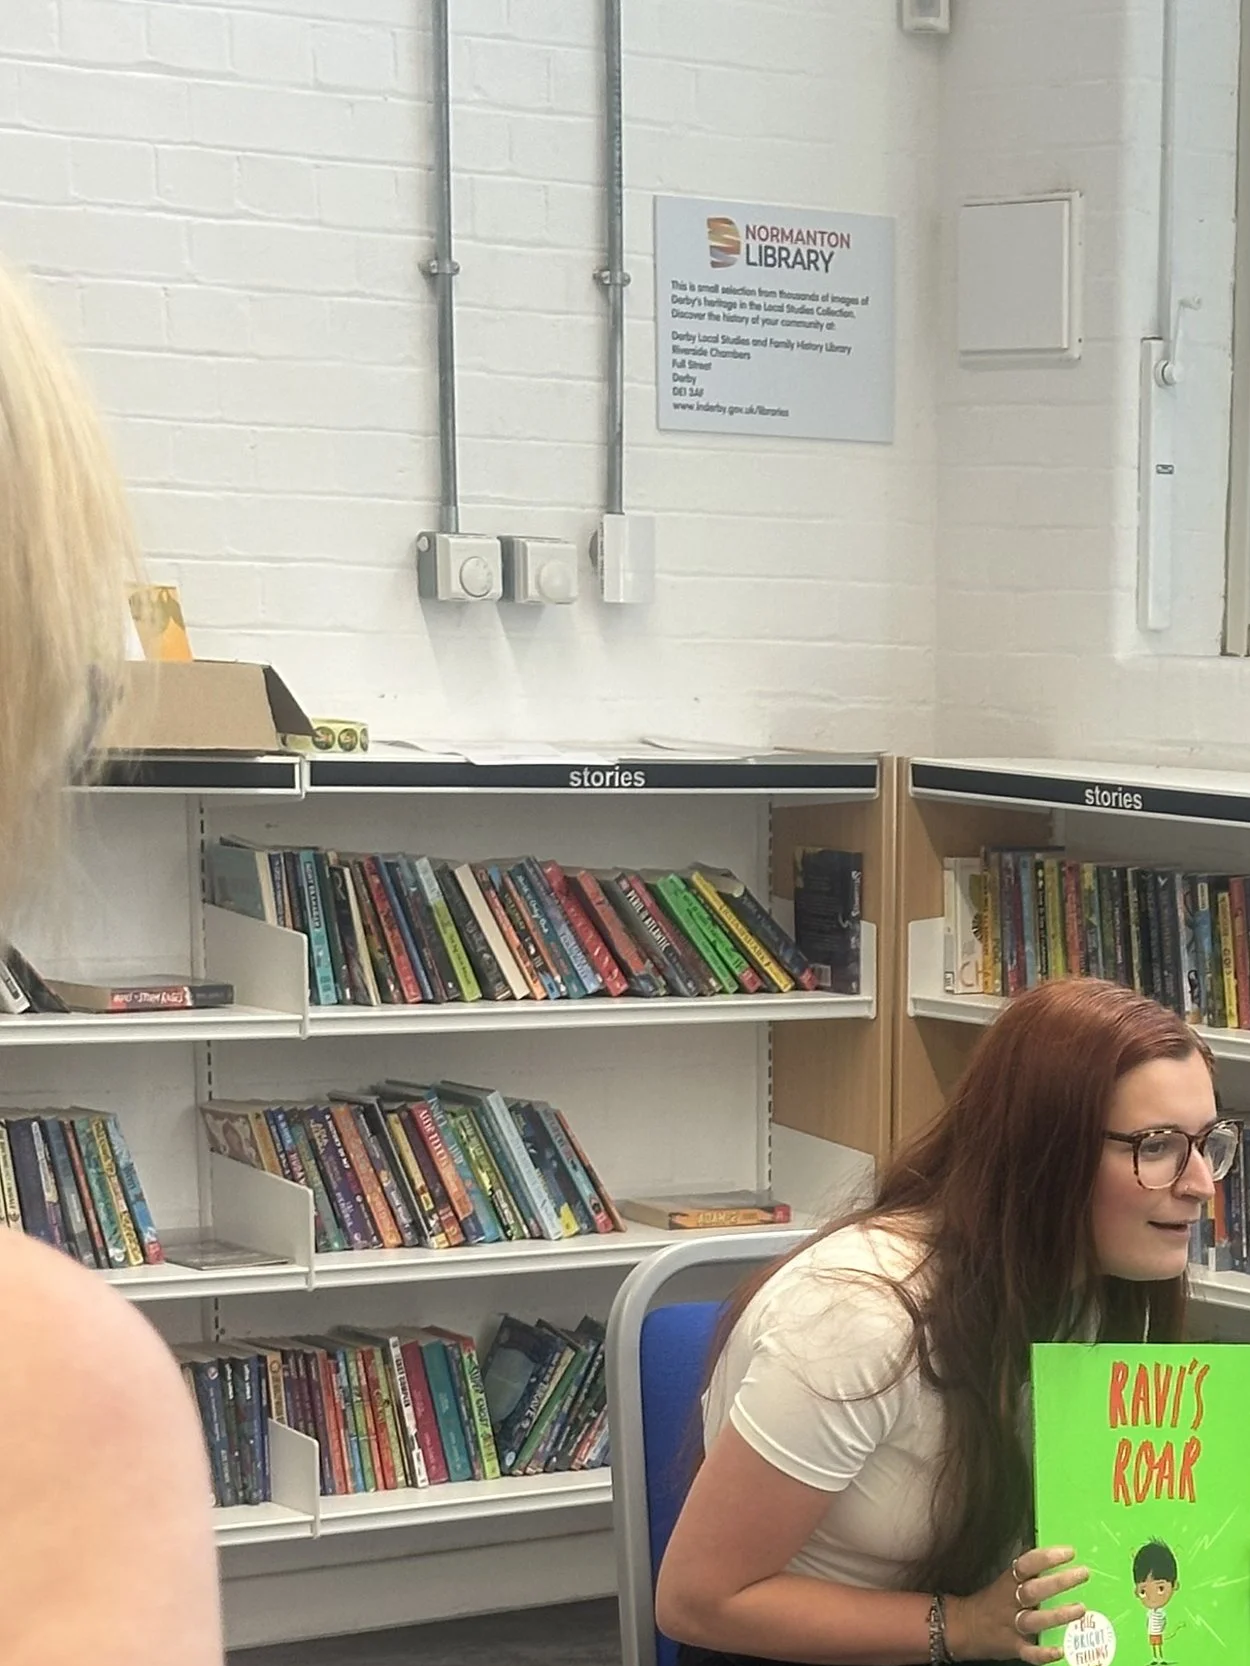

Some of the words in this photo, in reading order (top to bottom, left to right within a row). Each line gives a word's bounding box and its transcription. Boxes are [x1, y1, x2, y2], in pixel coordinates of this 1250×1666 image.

[745, 224, 851, 249] NORMANTON
[745, 244, 835, 273] LIBRARY
[671, 294, 702, 308] Derby's
[703, 297, 737, 311] heritage
[764, 302, 784, 313] Local
[786, 303, 815, 315] Studies
[689, 282, 696, 292] is
[697, 284, 719, 293] small
[721, 285, 756, 296] selection
[779, 289, 819, 301] thousands
[831, 296, 859, 307] images
[671, 308, 705, 320] Discover
[707, 311, 721, 321] the
[722, 312, 749, 326] history
[780, 319, 824, 332] community
[671, 330, 697, 344] Derby
[698, 332, 719, 343] Local
[720, 334, 750, 346] Studies
[752, 336, 768, 347] and
[769, 338, 795, 351] Family
[796, 340, 824, 353] History
[825, 342, 852, 355] Library
[672, 345, 708, 357] Riverside
[710, 347, 751, 360] Chambers
[687, 360, 712, 371] Street
[672, 372, 697, 385] Derby
[568, 764, 646, 788] stories
[1084, 784, 1144, 811] stories
[625, 889, 645, 914] PERIL
[642, 915, 670, 951] ATLANTIC
[1109, 1356, 1211, 1431] RAVI'S
[474, 1396, 490, 1429] GHOST
[1112, 1435, 1202, 1507] ROAR
[1073, 1629, 1106, 1651] BRIGHT
